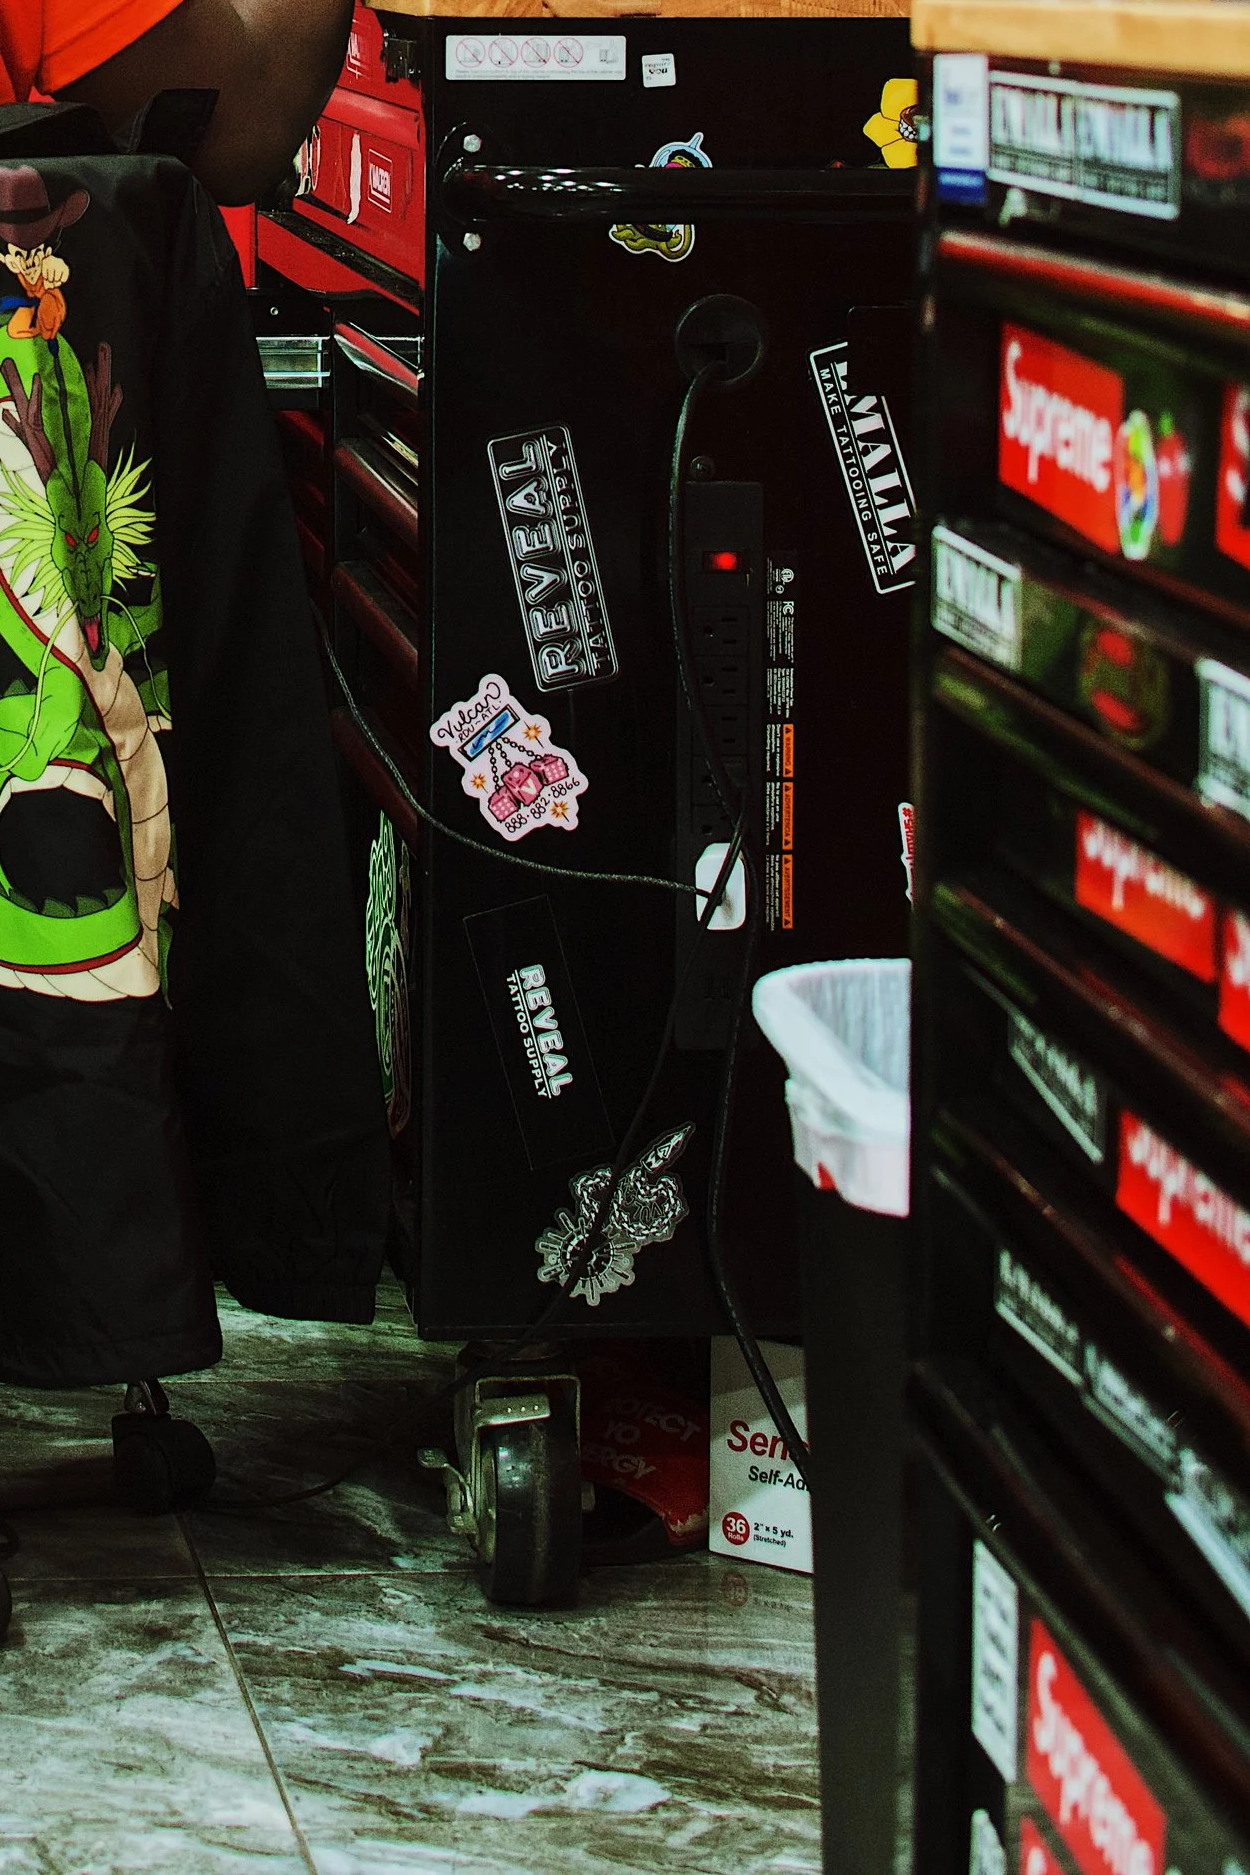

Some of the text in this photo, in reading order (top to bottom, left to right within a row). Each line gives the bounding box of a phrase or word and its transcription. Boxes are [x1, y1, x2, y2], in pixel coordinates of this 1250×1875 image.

[820, 368, 888, 576] MAKE TATTOOING SAFE
[1002, 339, 1113, 493] Supreme
[499, 439, 587, 683] REVEAL
[548, 440, 611, 670] TATTOO SUPPLY
[437, 681, 501, 739] Vulcan
[506, 973, 547, 1098] TATTOO SUPPLY
[519, 963, 574, 1097] REVEAL
[726, 1517, 747, 1535] 36
[728, 1532, 744, 1542] Rolls
[753, 1533, 787, 1548] (Stretched)
[772, 1526, 778, 1535] 5
[780, 1529, 794, 1538] yd.
